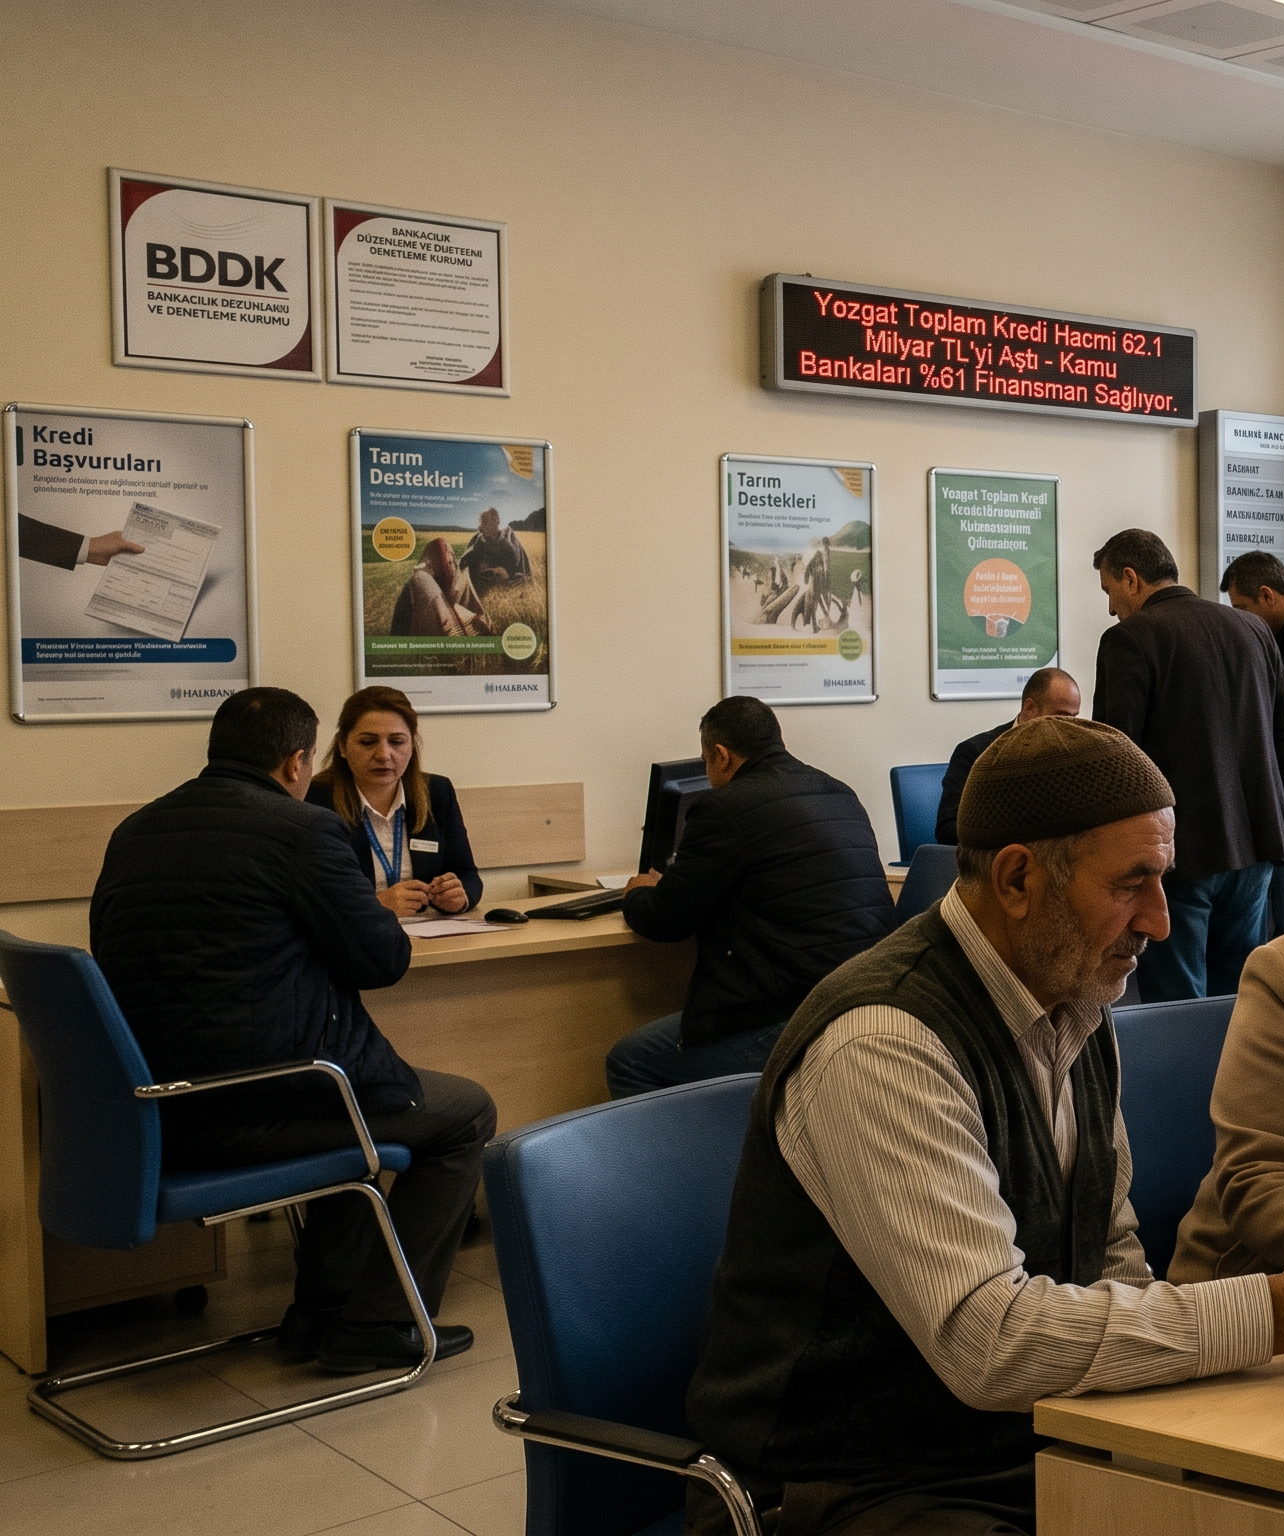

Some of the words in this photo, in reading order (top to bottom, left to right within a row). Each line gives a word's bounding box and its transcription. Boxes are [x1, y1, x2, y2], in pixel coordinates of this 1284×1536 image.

[392, 227, 451, 243] BANKACILIK
[419, 241, 432, 252] VE
[146, 242, 288, 293] BDDK
[430, 254, 473, 267] KURUMU
[147, 291, 219, 307] BANKACILIK
[147, 304, 163, 315] VE
[166, 306, 237, 322] DENETLEME
[240, 313, 290, 326] KURUMU
[814, 291, 898, 327] Yozgat
[904, 303, 986, 336] Toplam
[993, 315, 1048, 343] Kredi
[1054, 323, 1117, 352] Hacmi
[1122, 333, 1162, 358] 62.1
[865, 329, 935, 361] Milyar
[941, 338, 993, 369] TL'yi
[999, 345, 1039, 373] Aştı
[1060, 351, 1117, 379] Kamu
[800, 350, 911, 385] Bankaları
[919, 363, 965, 391] %61
[975, 370, 1088, 402] Finansman
[1095, 383, 1179, 414] Sağlıyor.
[32, 425, 93, 446] Kredi
[33, 448, 162, 473] Başvuruları
[369, 447, 423, 466] Tarım
[370, 468, 464, 489] Destekleri
[737, 472, 781, 489] Tarım
[738, 491, 816, 509] Destekleri
